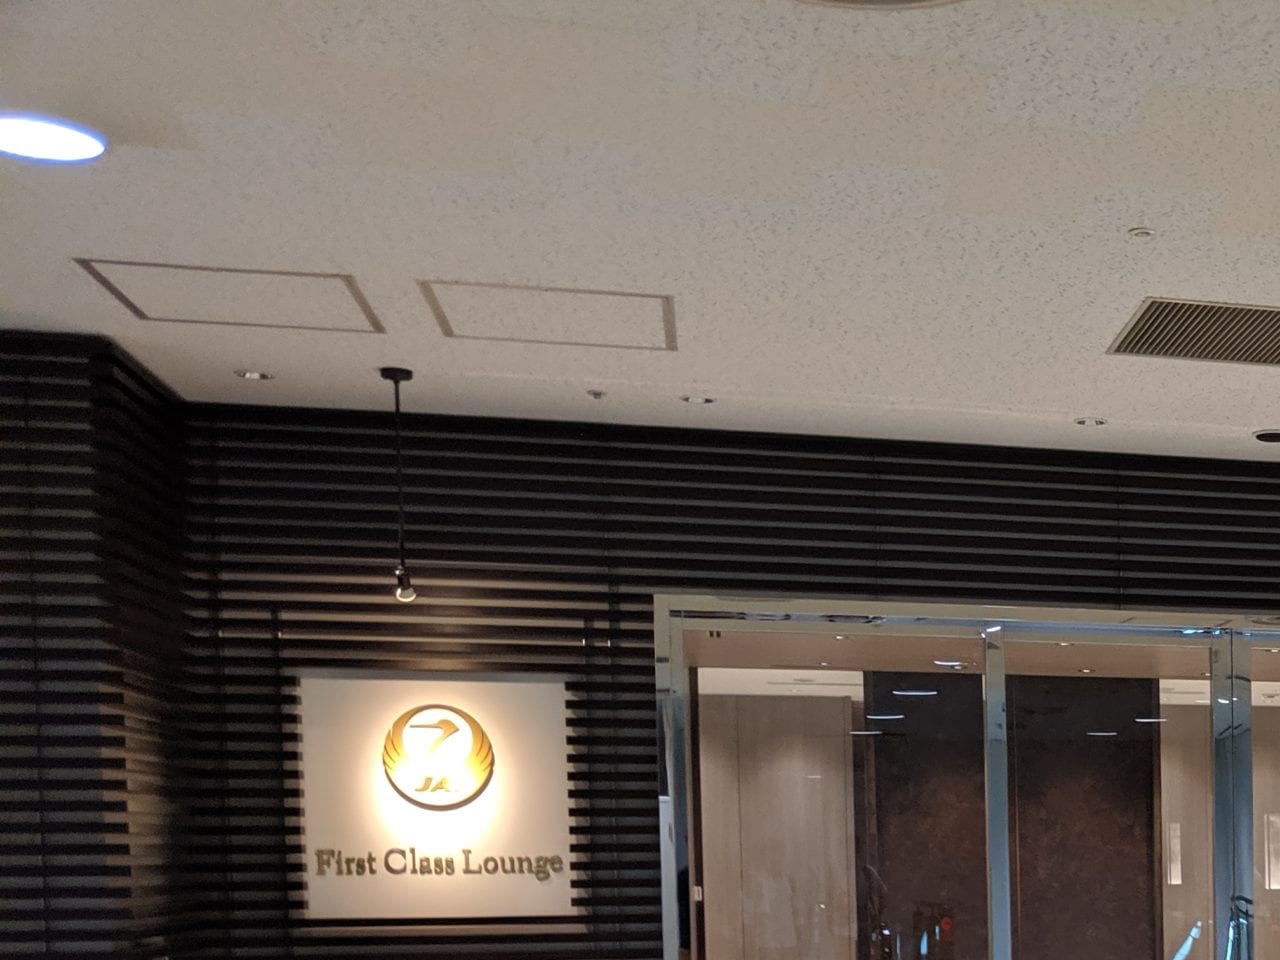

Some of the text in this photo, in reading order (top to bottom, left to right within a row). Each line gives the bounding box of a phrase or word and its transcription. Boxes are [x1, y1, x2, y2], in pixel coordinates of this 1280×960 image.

[414, 776, 460, 793] JA
[314, 847, 564, 882] First Class Lounge
